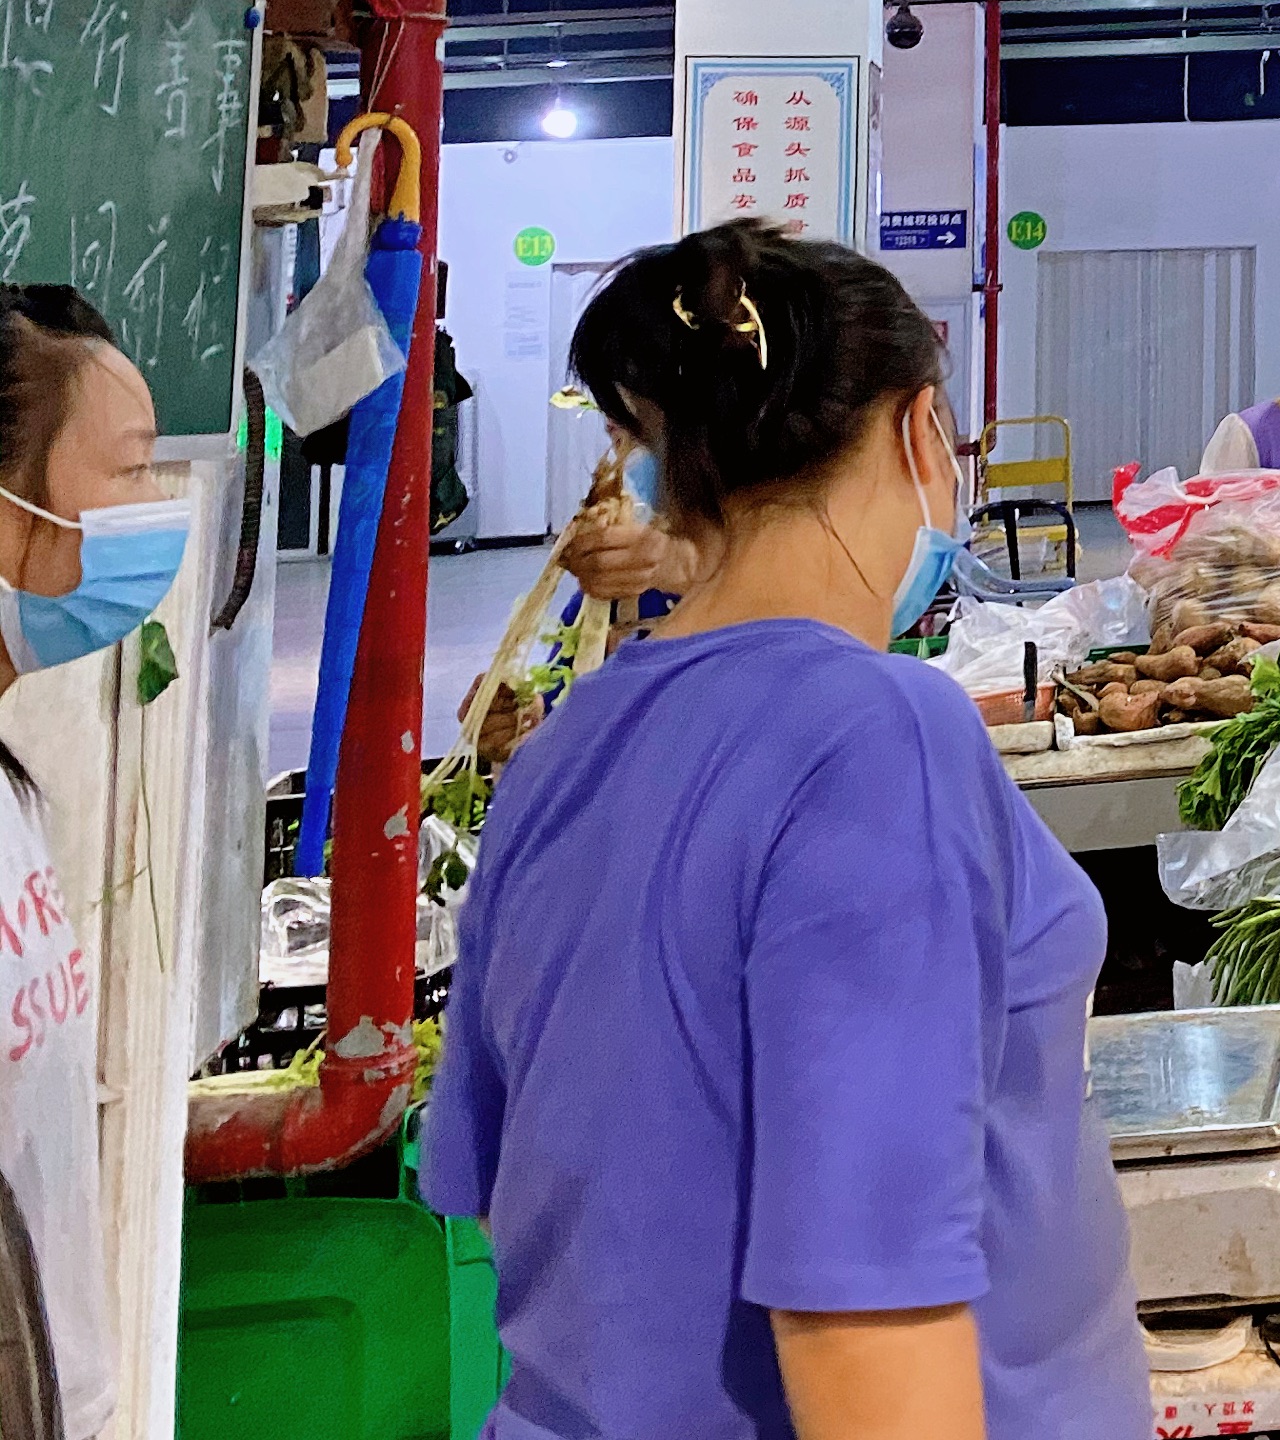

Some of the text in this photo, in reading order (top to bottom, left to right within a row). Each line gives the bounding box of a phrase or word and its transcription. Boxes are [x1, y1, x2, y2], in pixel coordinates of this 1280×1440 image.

[731, 89, 759, 209] 确保食品安
[1010, 220, 1045, 242] E14
